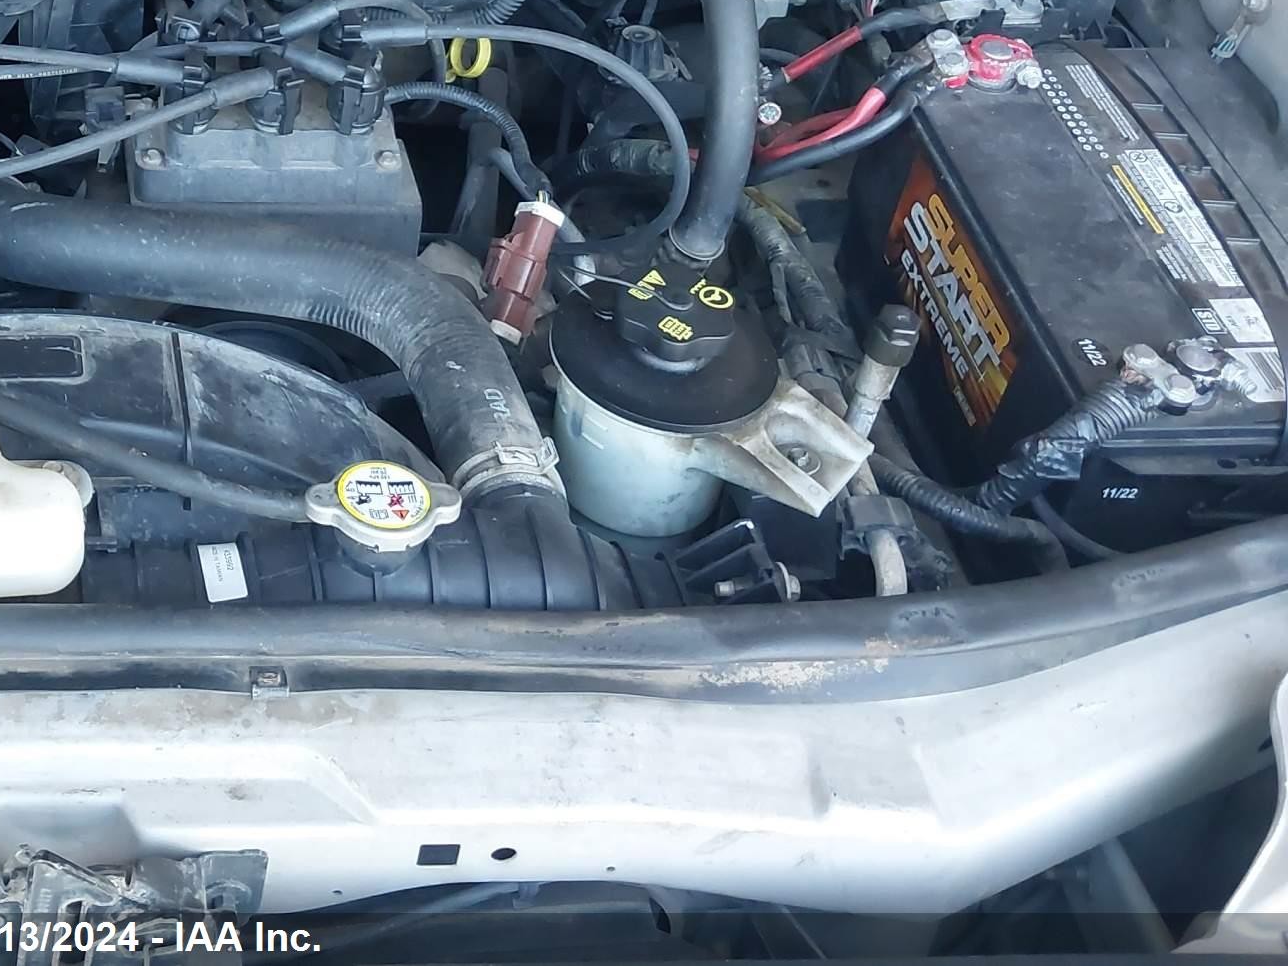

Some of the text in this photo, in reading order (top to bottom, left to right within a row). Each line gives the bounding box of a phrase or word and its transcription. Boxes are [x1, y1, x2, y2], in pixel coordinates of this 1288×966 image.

[903, 201, 1001, 366] START
[928, 193, 1011, 355] SUPER
[901, 249, 969, 380] EXTREME
[1078, 338, 1108, 367] 11/22
[1197, 310, 1221, 332] STD
[1101, 487, 1139, 499] 11/22
